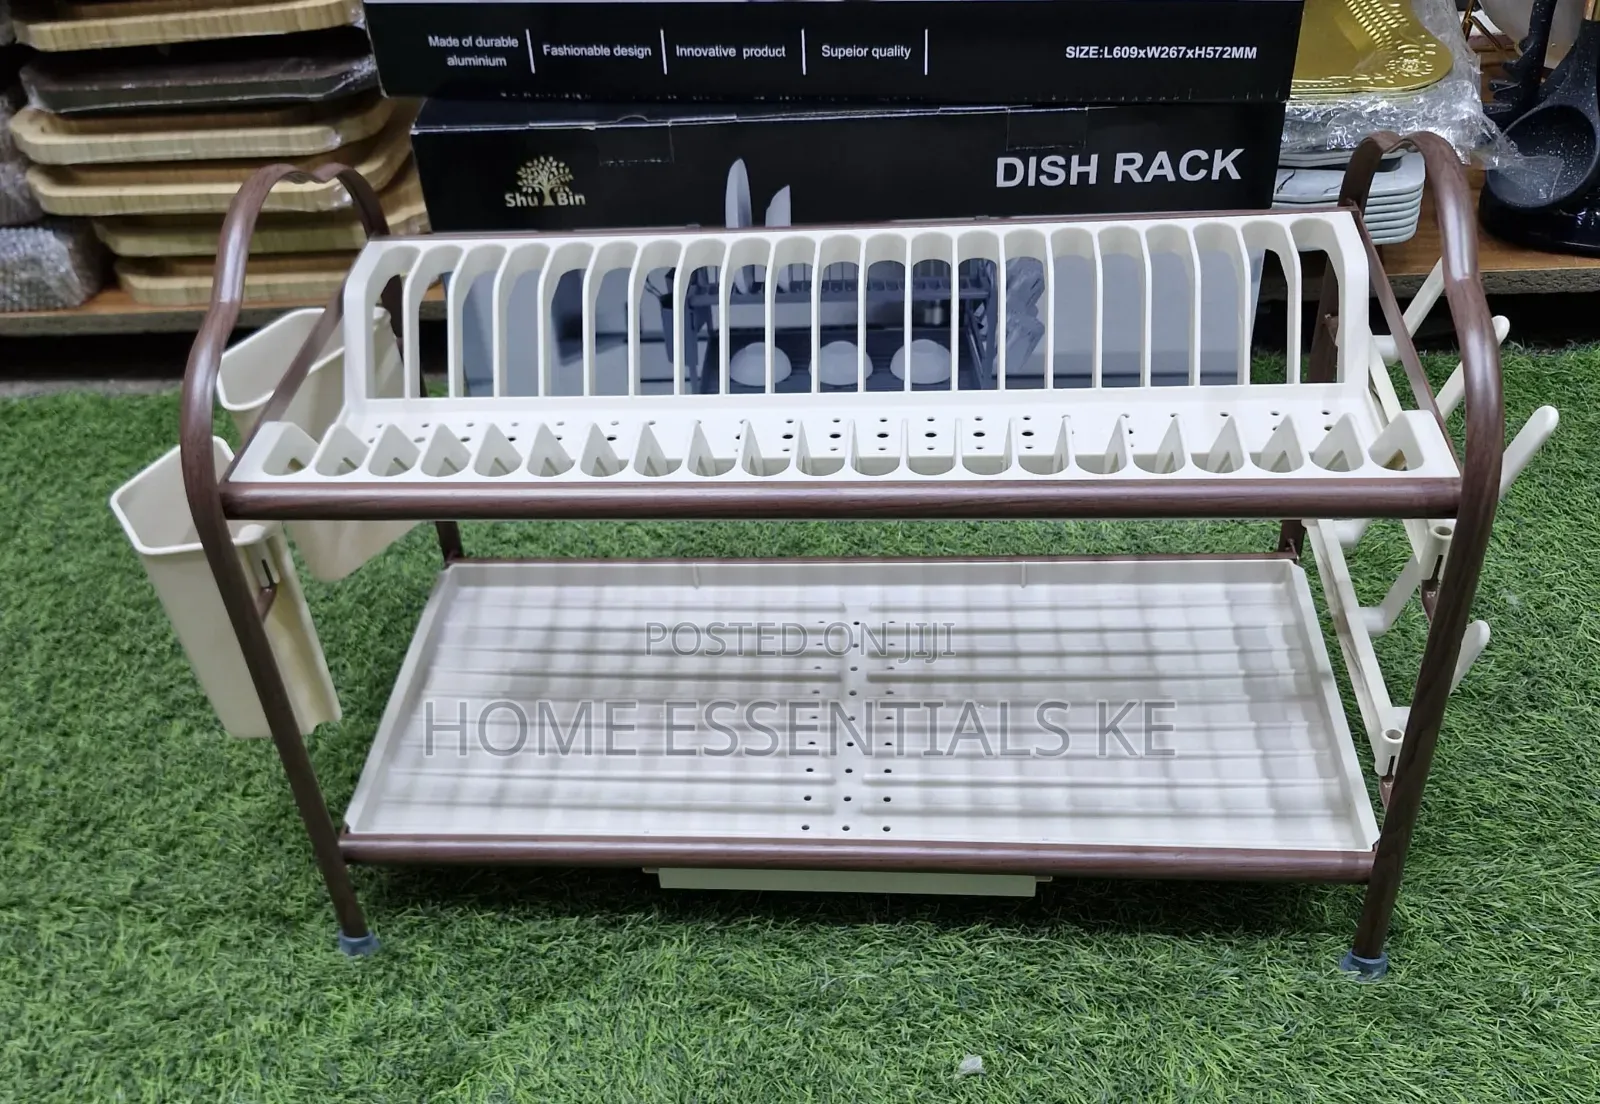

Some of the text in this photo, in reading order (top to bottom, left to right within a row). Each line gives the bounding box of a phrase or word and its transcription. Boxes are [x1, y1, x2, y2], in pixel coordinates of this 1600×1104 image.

[427, 35, 519, 48] Made of durable
[542, 44, 652, 59] Fashionable design
[675, 44, 786, 60] Innovative product
[821, 44, 912, 60] Supeior quality
[1065, 45, 1258, 60] SIZE:L609xW267xH572MM
[446, 55, 507, 67] aluminium
[995, 148, 1243, 188] DISH RACK
[504, 191, 586, 208] Shu Bin
